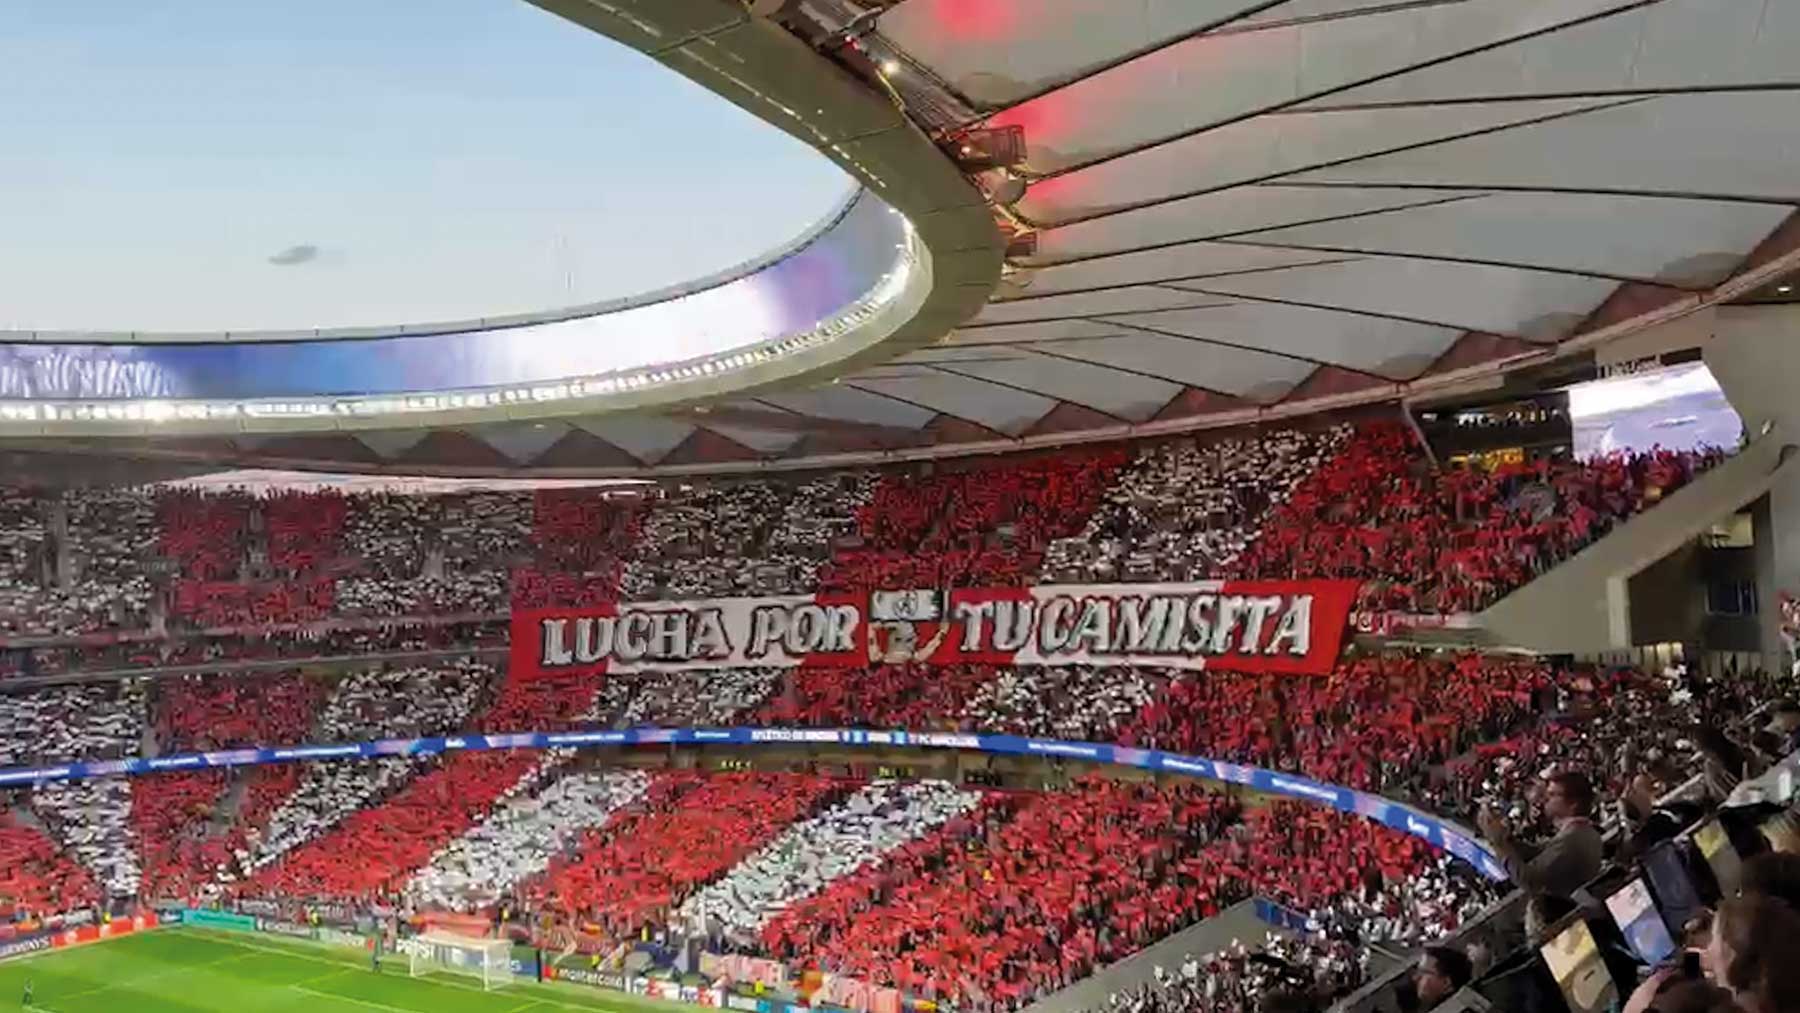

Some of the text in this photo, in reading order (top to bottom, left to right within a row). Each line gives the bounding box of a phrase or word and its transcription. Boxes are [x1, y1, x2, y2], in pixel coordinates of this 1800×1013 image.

[541, 608, 733, 666] LUCHA
[744, 604, 860, 658] POR
[956, 600, 1035, 652] TU
